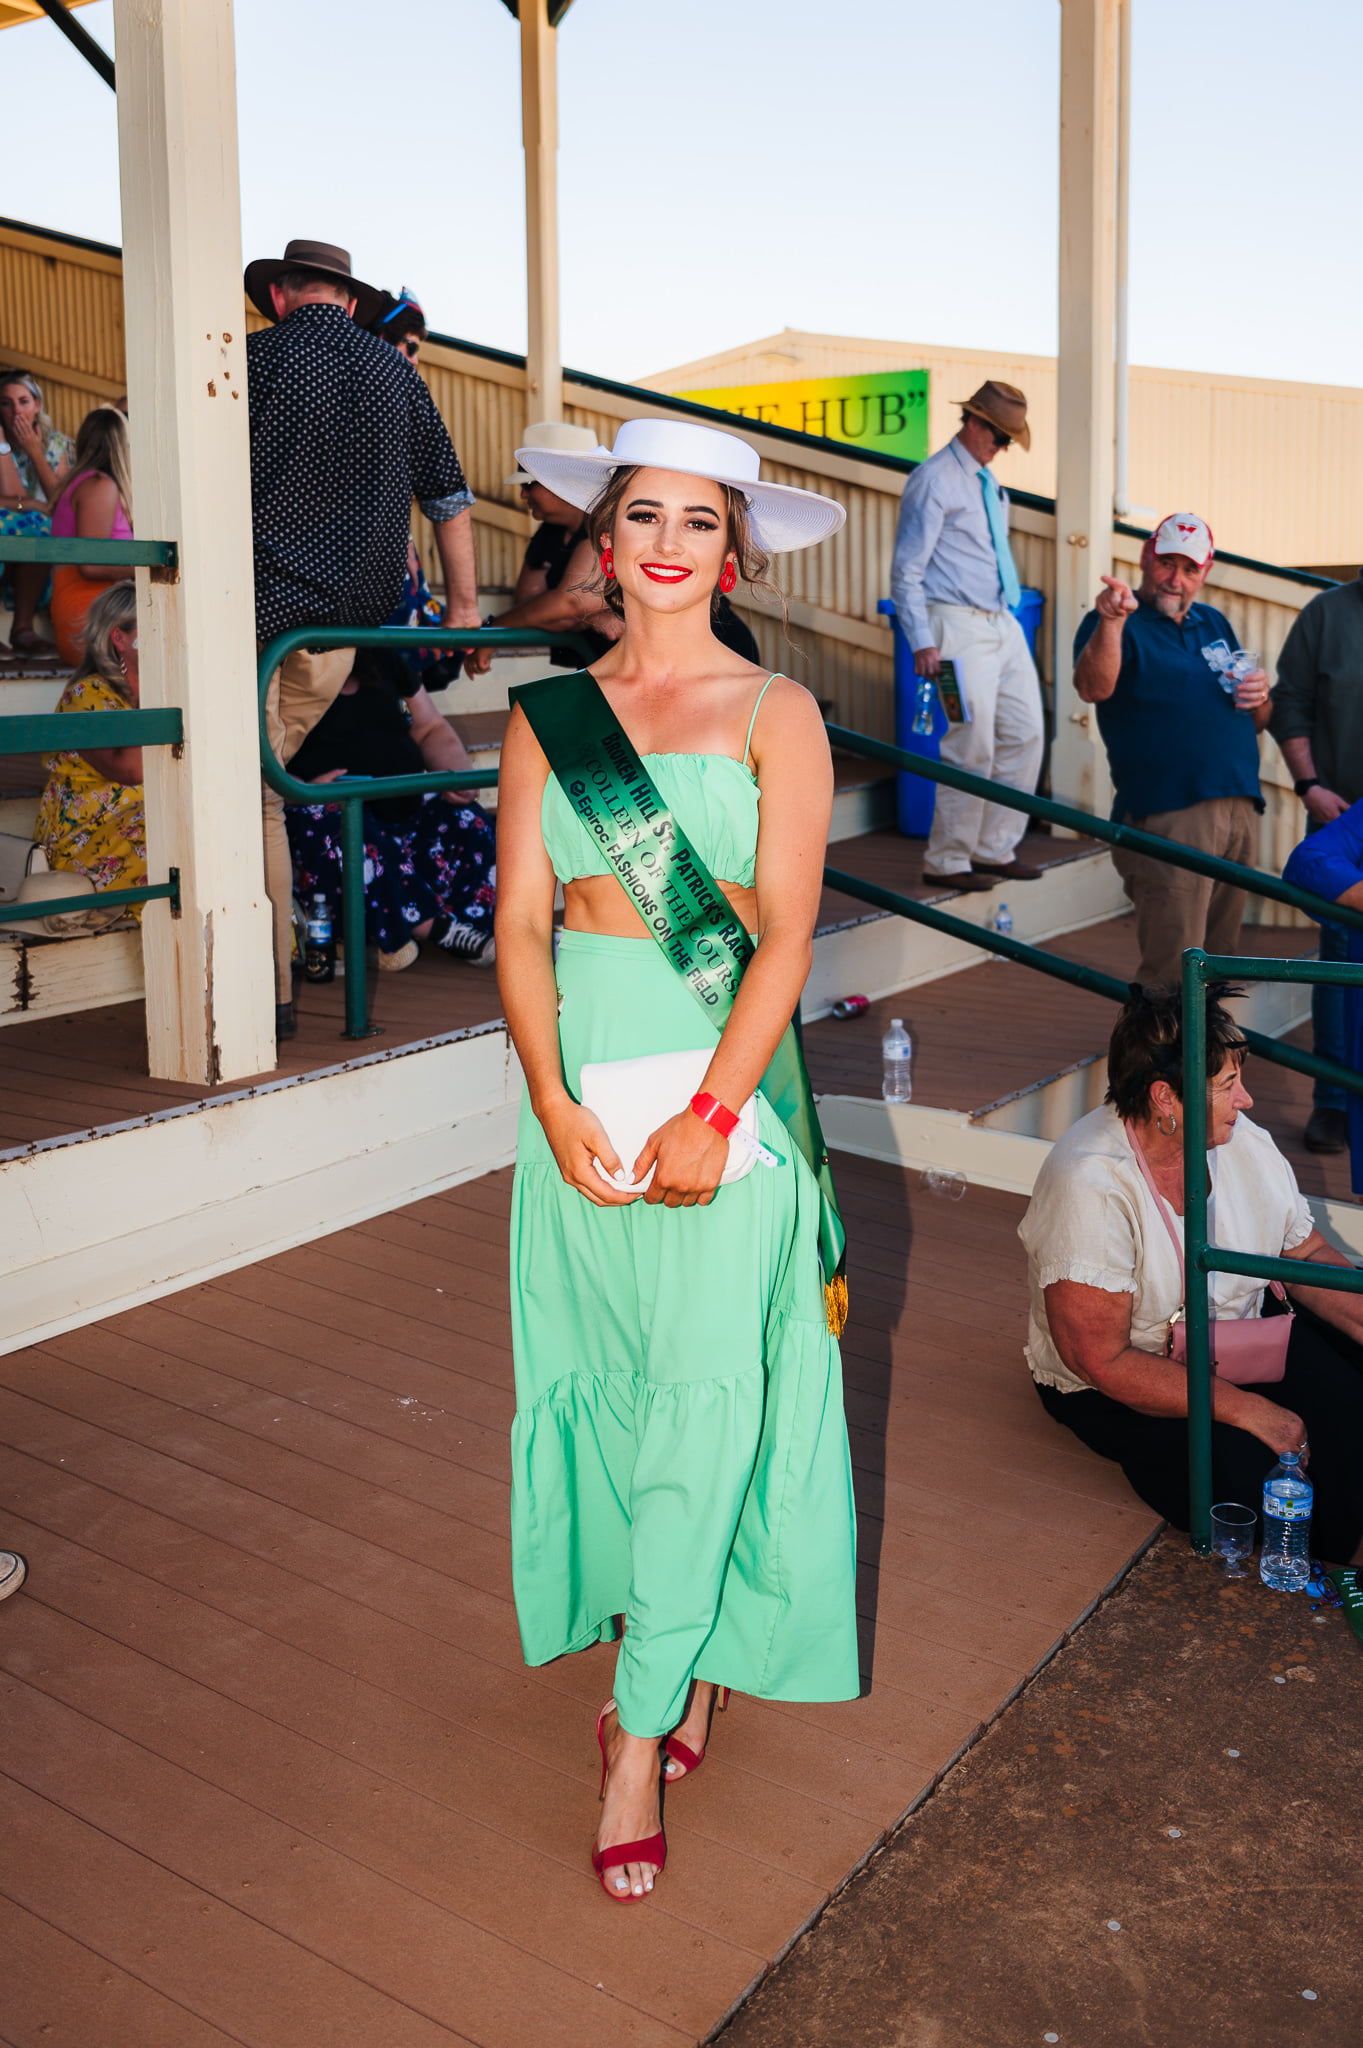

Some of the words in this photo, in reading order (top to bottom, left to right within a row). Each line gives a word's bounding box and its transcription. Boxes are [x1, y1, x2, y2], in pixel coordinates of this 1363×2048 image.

[577, 795, 610, 843] Epiroc
[607, 843, 658, 916] FASHIONS
[653, 917, 676, 942] ON
[669, 940, 694, 970] THE
[687, 967, 719, 1005] FIELD
[586, 760, 645, 848] COLLEEN
[641, 852, 666, 878] OF
[660, 880, 694, 927] THE
[688, 927, 740, 999] COURS
[602, 731, 639, 785] BROKEN
[629, 783, 658, 823] HILL
[653, 821, 676, 852] ST.
[670, 848, 725, 925] PATRICK'S
